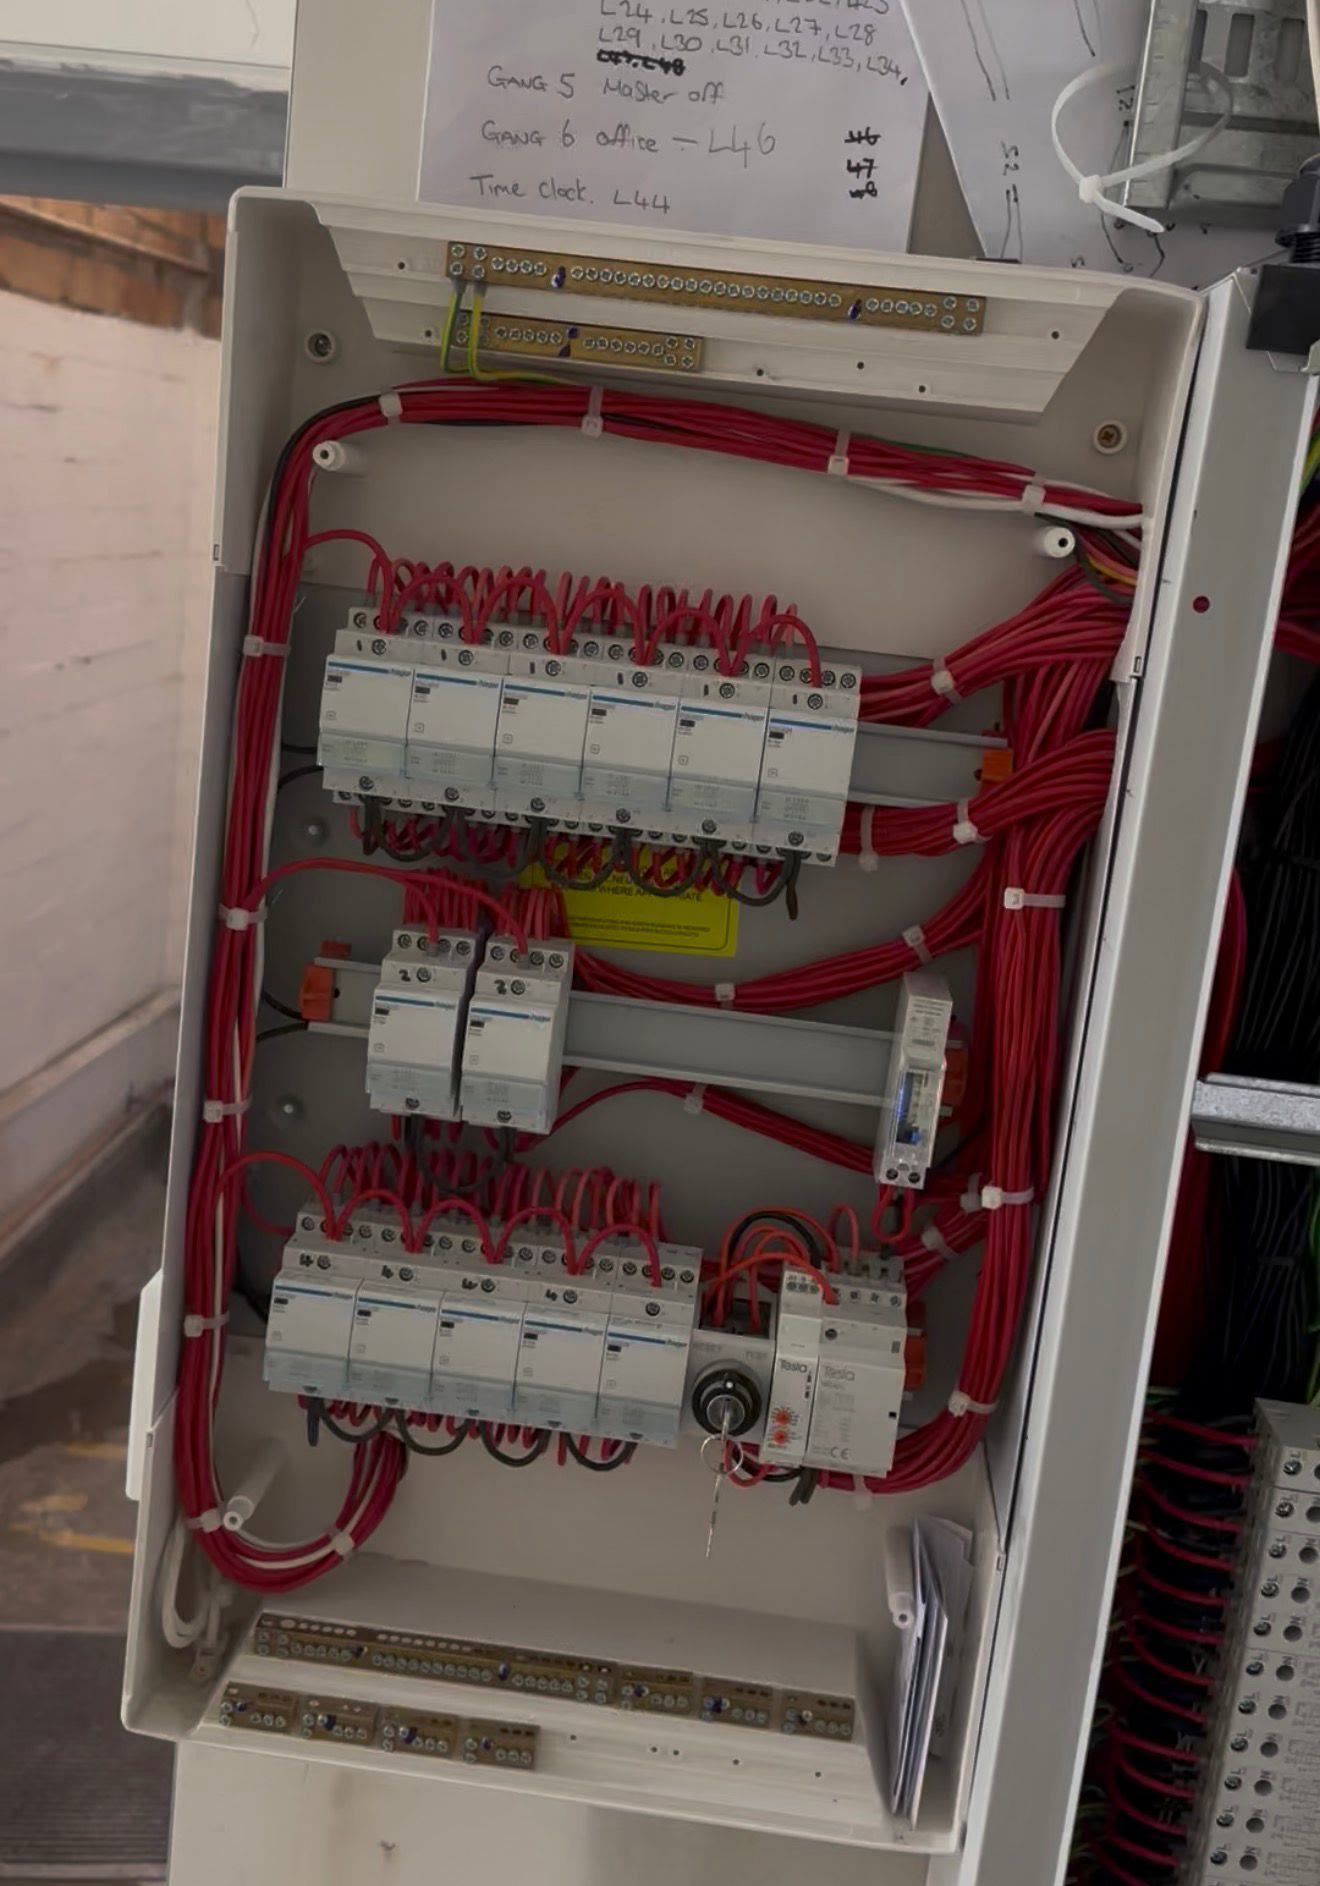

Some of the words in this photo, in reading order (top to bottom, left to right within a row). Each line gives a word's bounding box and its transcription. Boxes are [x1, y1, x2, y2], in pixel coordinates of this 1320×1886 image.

[834, 24, 876, 47] L28
[556, 73, 576, 99] 5
[687, 81, 727, 105] off
[561, 118, 576, 148] 6
[708, 122, 777, 169] L46
[469, 173, 527, 198] Time
[612, 189, 671, 214] L44
[398, 968, 412, 982] 2
